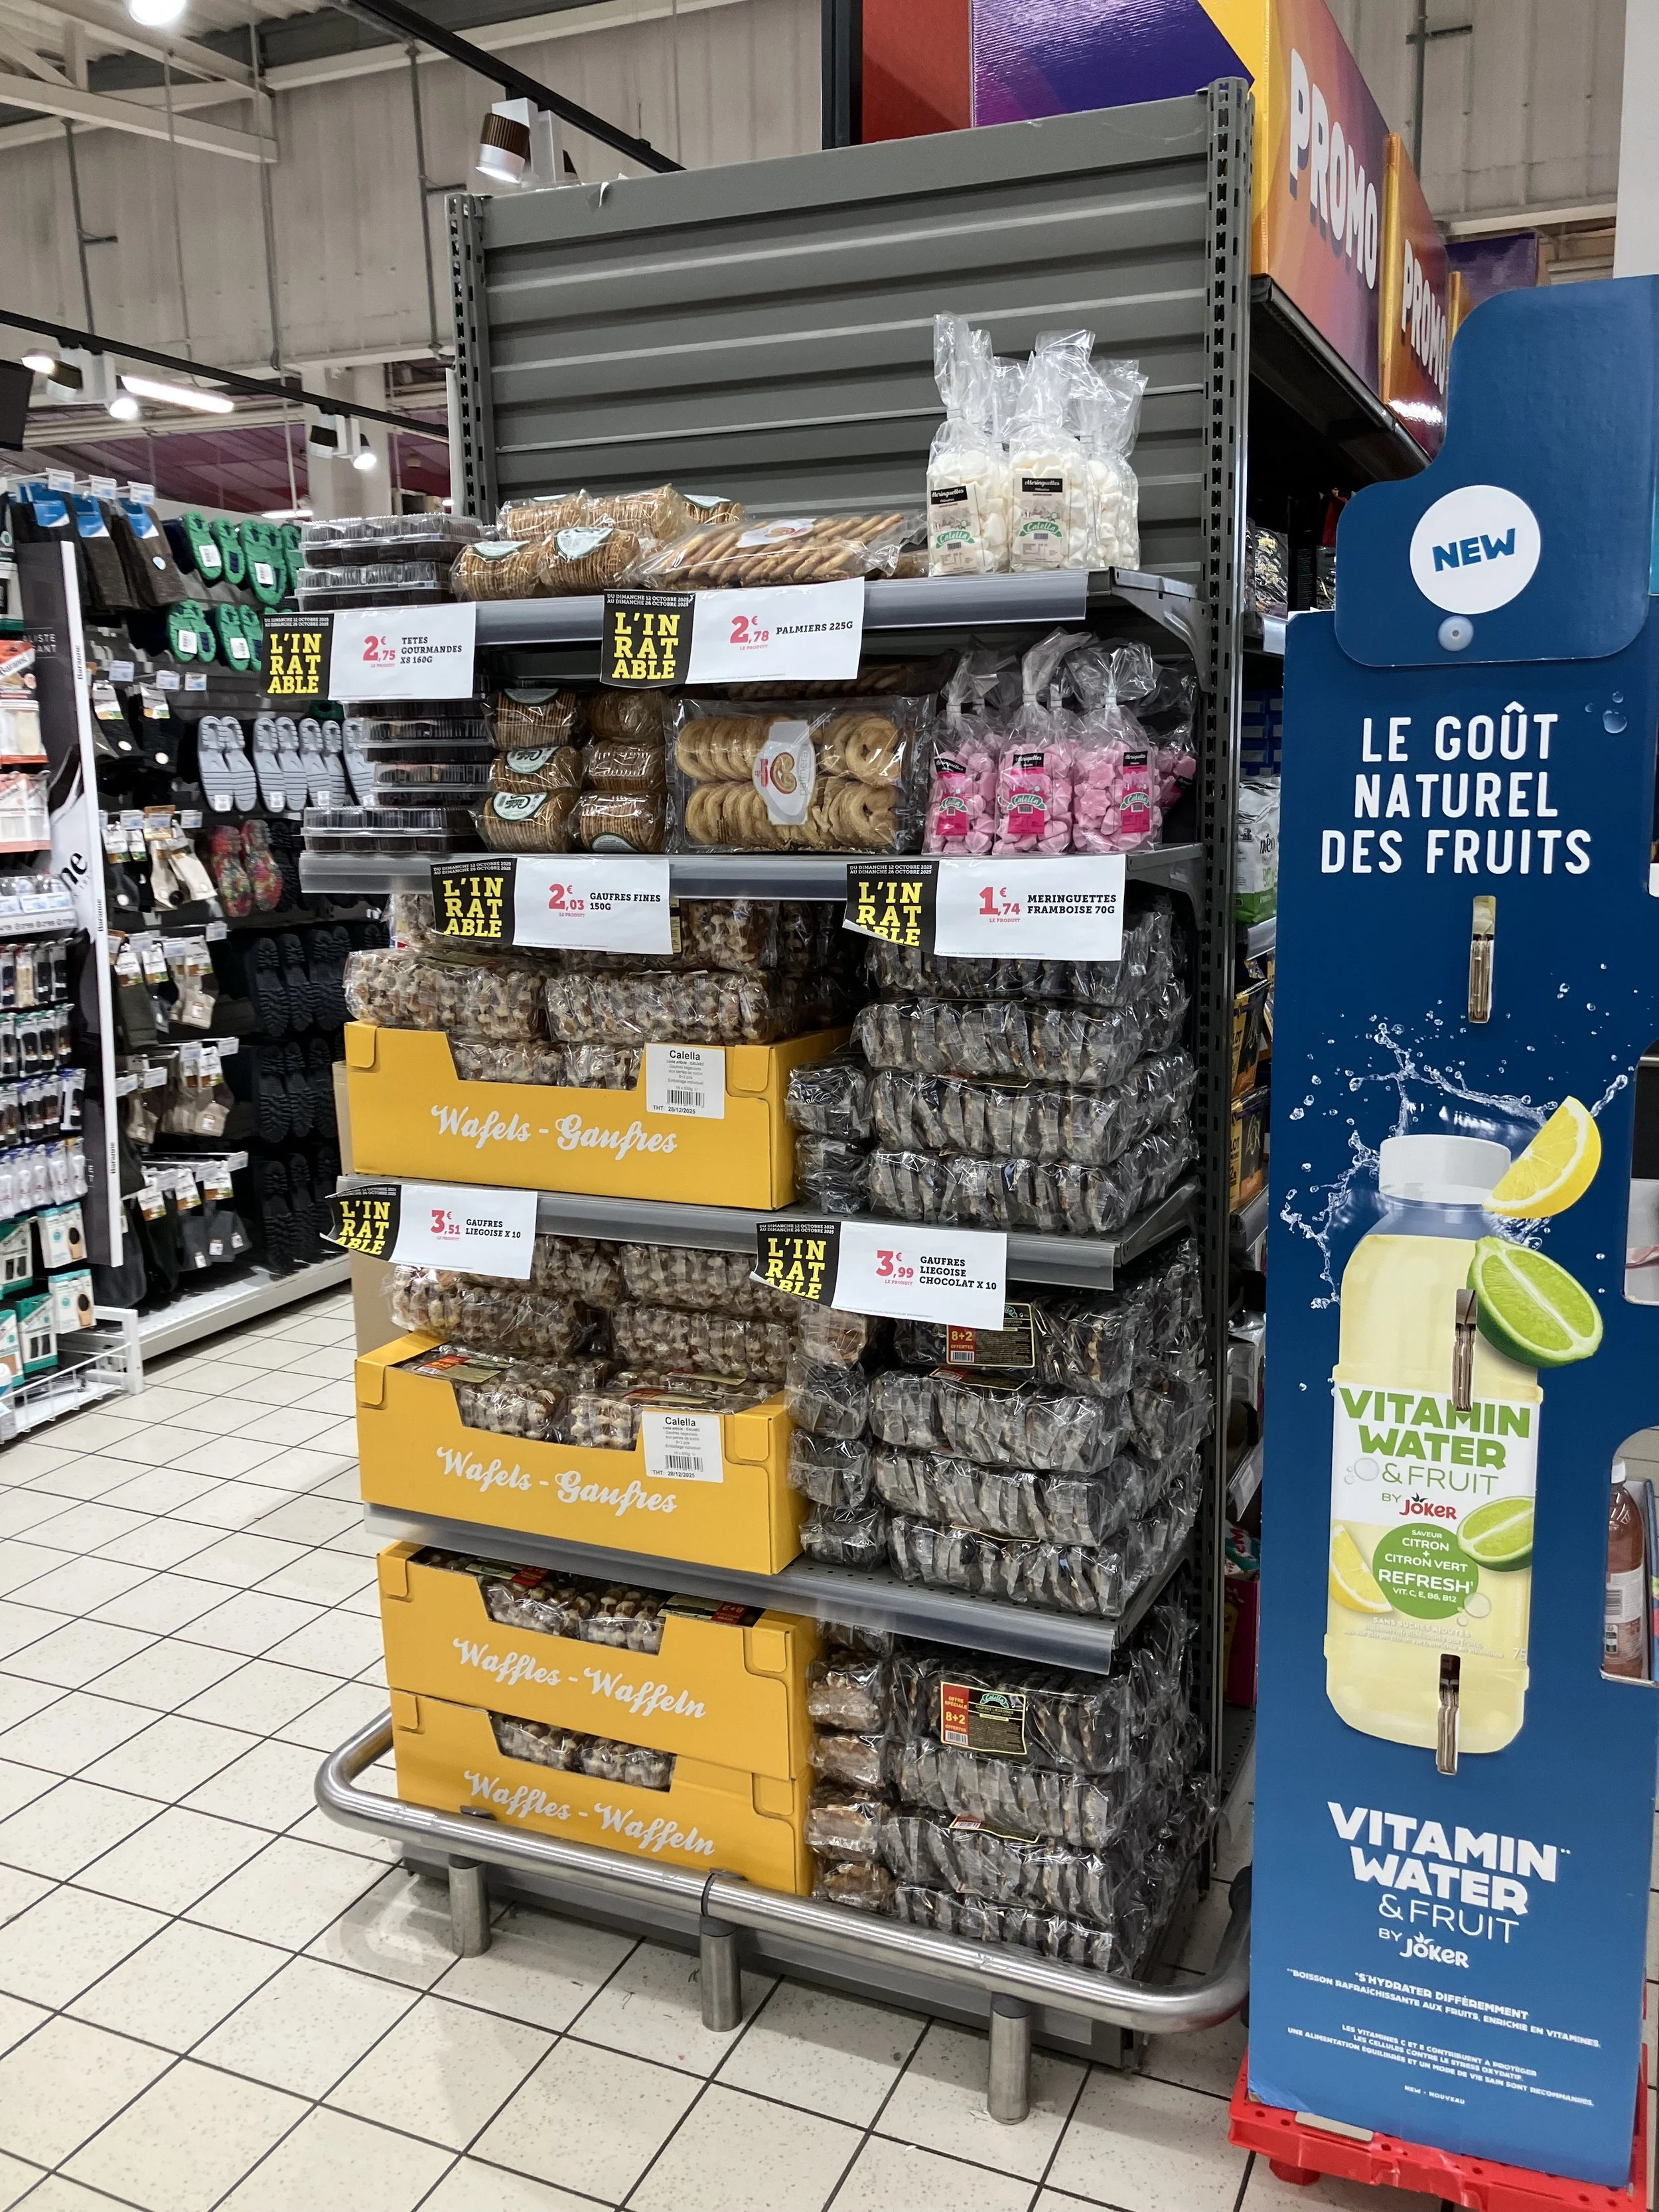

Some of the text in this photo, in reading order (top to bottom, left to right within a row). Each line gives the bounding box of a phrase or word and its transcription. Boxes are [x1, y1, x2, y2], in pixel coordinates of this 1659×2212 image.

[1289, 48, 1378, 290] PROMO
[1402, 238, 1447, 396] PROMO
[1432, 528, 1516, 572] NEW
[614, 612, 680, 636] L'IN
[776, 621, 853, 635] PALMIERS 225G
[270, 633, 322, 654] L'IN
[401, 645, 463, 654] GOURMANDES
[614, 636, 679, 659] RAT
[269, 655, 321, 675] RAT
[612, 659, 676, 680] ABLE
[267, 676, 319, 694] ABLE
[1362, 700, 1559, 763] LE GOÛT
[1354, 771, 1558, 818] NATUREL
[1321, 829, 1592, 875] DES FRUITS
[443, 877, 504, 897] L'IN
[859, 881, 923, 903] L'IN
[444, 898, 503, 919] RAT
[590, 893, 661, 903] GAUFRES FINES
[1027, 894, 1116, 903] MERINGUETTES
[856, 905, 922, 927] RAT
[1027, 905, 1115, 915] FRAMBOISE 70G
[443, 918, 502, 938] ABLE
[670, 1050, 700, 1061] Calella
[431, 1104, 678, 1161] Wafels Gaufres
[339, 1201, 391, 1220] L'IN
[338, 1218, 390, 1240] RAT
[465, 1228, 503, 1237] LIEGOISE
[466, 1218, 503, 1228] GAUFRES
[768, 1238, 827, 1261] L'IN
[764, 1258, 826, 1282] RAT
[920, 1256, 966, 1267] GAUFRES
[920, 1266, 967, 1277] LIEGOISE
[919, 1276, 975, 1288] CHOCOLAT
[985, 1282, 997, 1290] 10
[951, 1331, 973, 1341] 8+2
[665, 1416, 695, 1426] Calella
[1338, 1387, 1531, 1439] VITAMIN
[1358, 1424, 1506, 1471] WATER
[436, 1447, 677, 1516] Wafels Gaufres
[1382, 1462, 1499, 1495] & FRUIT
[1382, 1493, 1402, 1503] BY
[1402, 1537, 1449, 1552] CITRON
[1411, 1529, 1443, 1539] SAVEUR
[1384, 1553, 1468, 1572] CITRON VERT
[1392, 1587, 1408, 1595] VIT.
[1427, 1592, 1441, 1601] B6,
[1442, 1594, 1457, 1603] B12
[1373, 1617, 1395, 1626] SANS
[1398, 1619, 1432, 1632] SUCRES
[453, 1637, 706, 1719] Waffles Waffeln
[946, 1712, 966, 1725] 8+2
[464, 1770, 715, 1856] Waffles Waffeln
[1350, 1846, 1529, 1915] WATER
[1378, 1893, 1520, 1943] & FRUIT
[1378, 1927, 1403, 1943] BY
[1435, 1992, 1529, 2020] DIFFÉREMMENT
[1422, 2002, 1443, 2012] AUX
[1483, 2015, 1528, 2031] ENRICHIE
[1530, 2026, 1544, 2035] EN
[1341, 2024, 1356, 2033] LES
[1357, 2028, 1399, 2044] VITAMINES
[1426, 2045, 1483, 2064] CONTRIBUENT
[1353, 2034, 1367, 2043] LES
[1368, 2038, 1404, 2053] CELLULES
[1406, 2048, 1439, 2062] CONTRE
[1451, 2059, 1480, 2071] STRESS
[1287, 2027, 1303, 2036] UNE
[1305, 2031, 1360, 2051] ALIMENTATION
[1419, 2061, 1431, 2069] UN
[1432, 2063, 1455, 2075] MODE
[1457, 2069, 1467, 2078] DE
[1469, 2072, 1483, 2081] VIE
[1484, 2076, 1504, 2087] SAIN
[1506, 2081, 1528, 2092] SONT
[1404, 2085, 1465, 2104] NEW NOUVEAU
